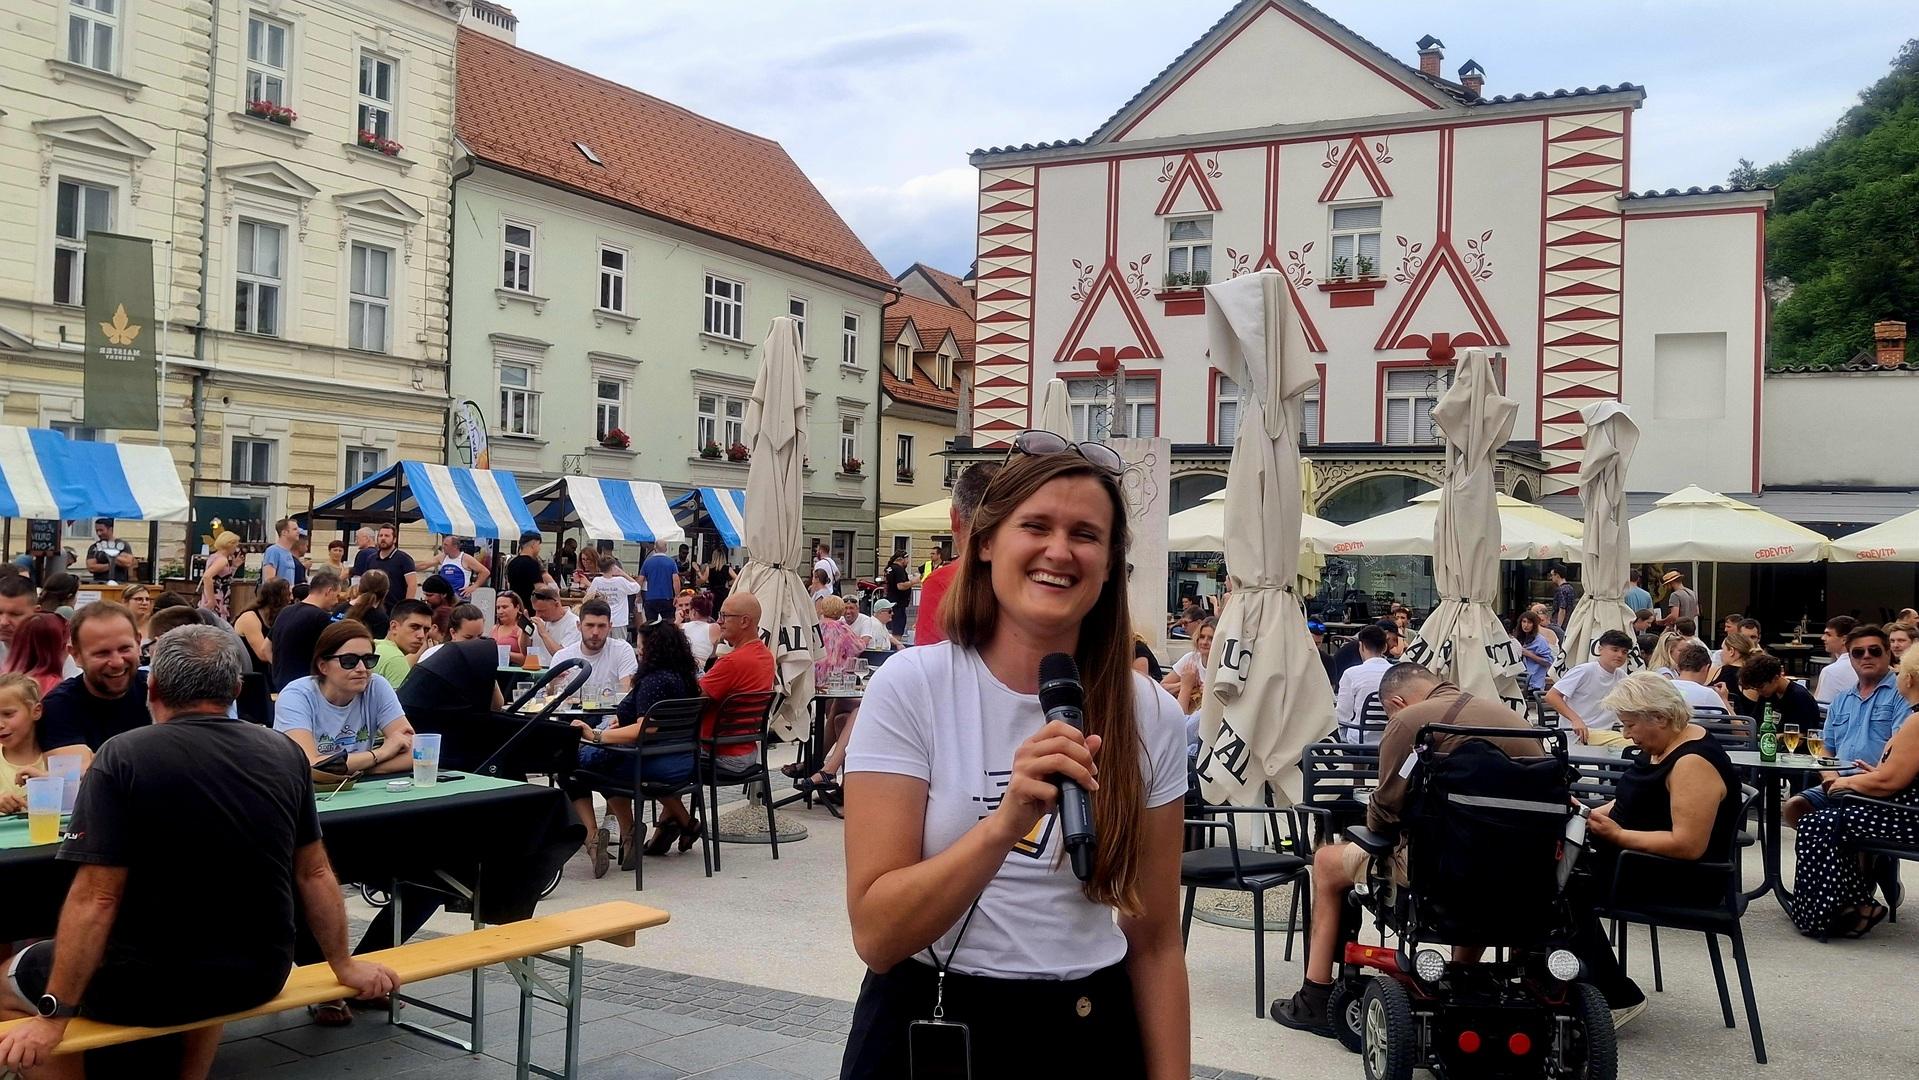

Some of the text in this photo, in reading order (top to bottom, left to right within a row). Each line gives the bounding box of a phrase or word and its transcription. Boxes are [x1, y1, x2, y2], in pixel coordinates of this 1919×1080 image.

[1333, 541, 1364, 552] CEDEVITA
[1755, 546, 1794, 560] CEDEVITA
[1856, 548, 1896, 560] CEDEVITA
